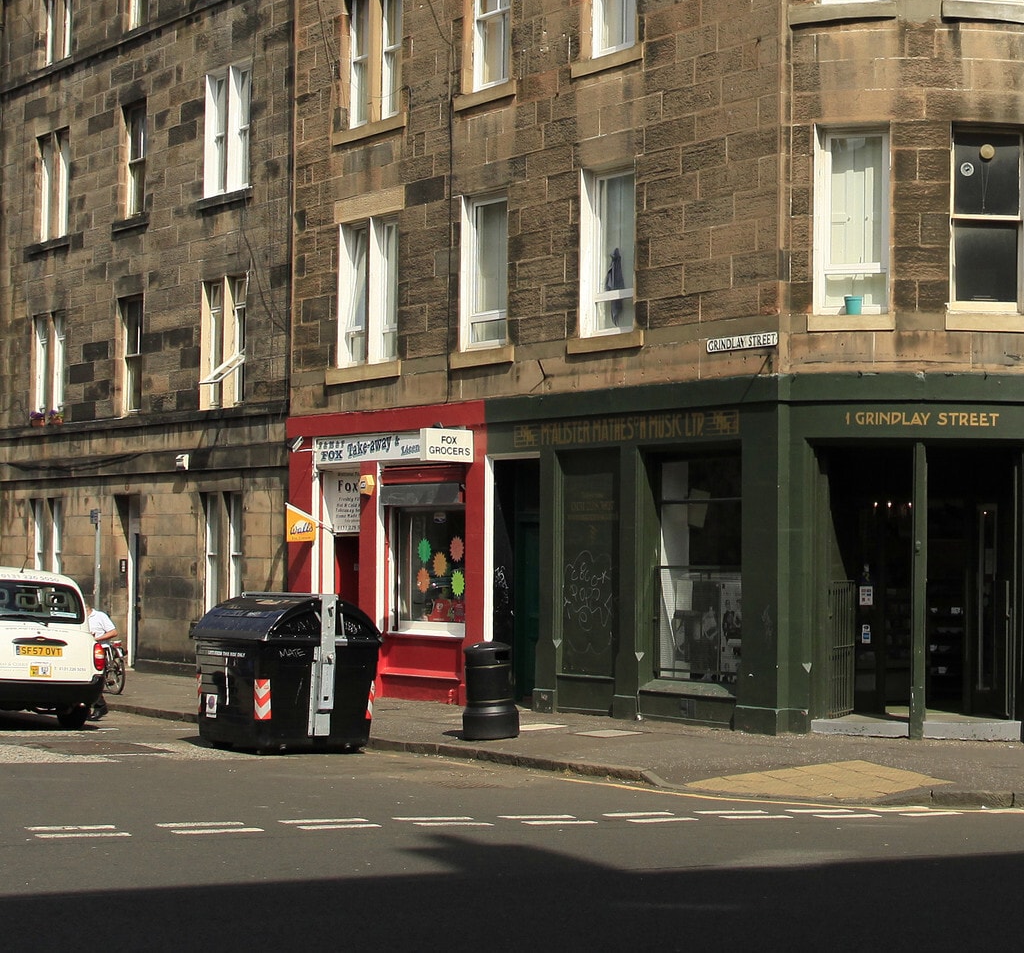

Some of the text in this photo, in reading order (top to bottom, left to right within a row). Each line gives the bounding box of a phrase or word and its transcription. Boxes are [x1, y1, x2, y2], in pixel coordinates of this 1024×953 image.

[708, 334, 776, 351] GRINDLAY STREET
[856, 412, 931, 426] GRINDLAY
[937, 412, 1000, 427] STREET
[651, 413, 683, 439] MUSIC
[441, 436, 458, 444] FOX
[320, 450, 343, 461] FOX
[428, 446, 470, 456] GROCERS
[21, 646, 60, 656] SF57 OVT
[279, 648, 306, 658] MATE
